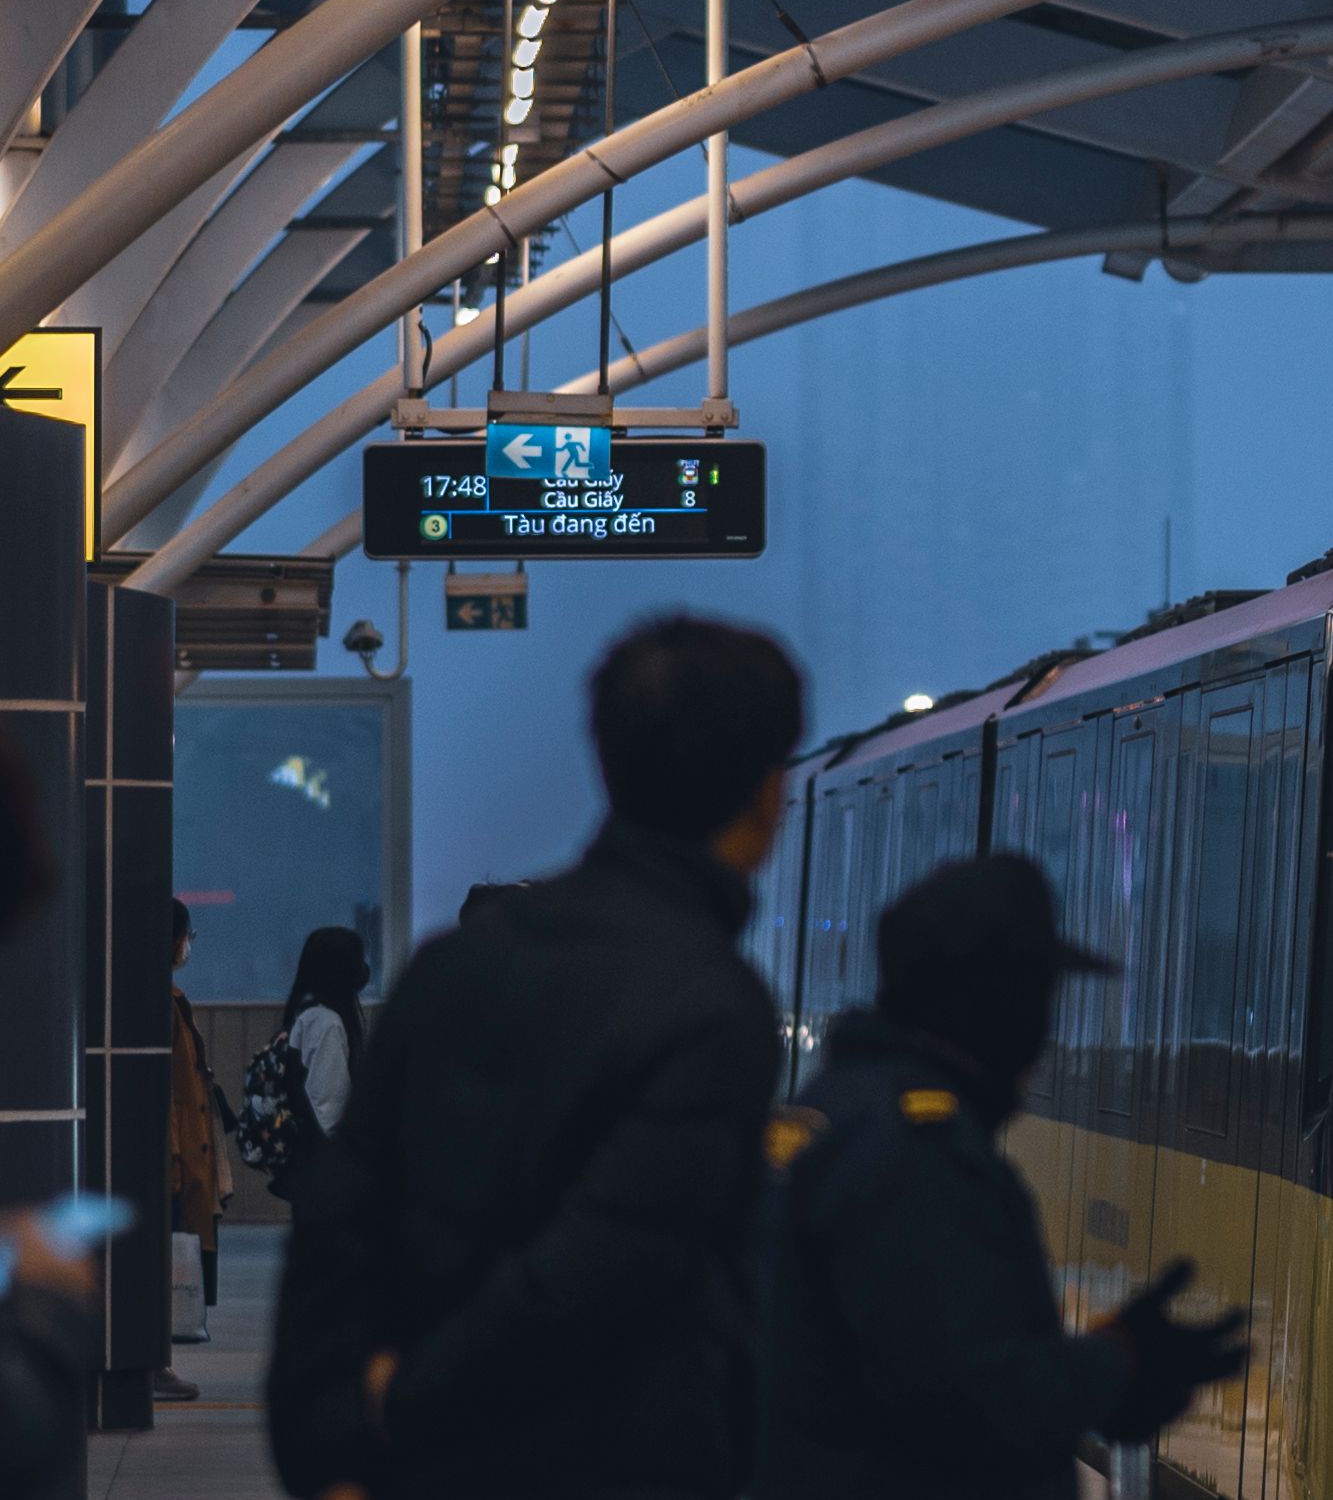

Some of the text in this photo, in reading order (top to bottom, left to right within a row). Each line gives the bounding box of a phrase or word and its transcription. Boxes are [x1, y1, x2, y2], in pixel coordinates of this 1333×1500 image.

[423, 475, 487, 497] 17:48
[544, 490, 624, 512] Cầu Giấy
[684, 491, 696, 507] 8
[432, 520, 440, 533] 3
[504, 512, 655, 539] Tàu đang đến
